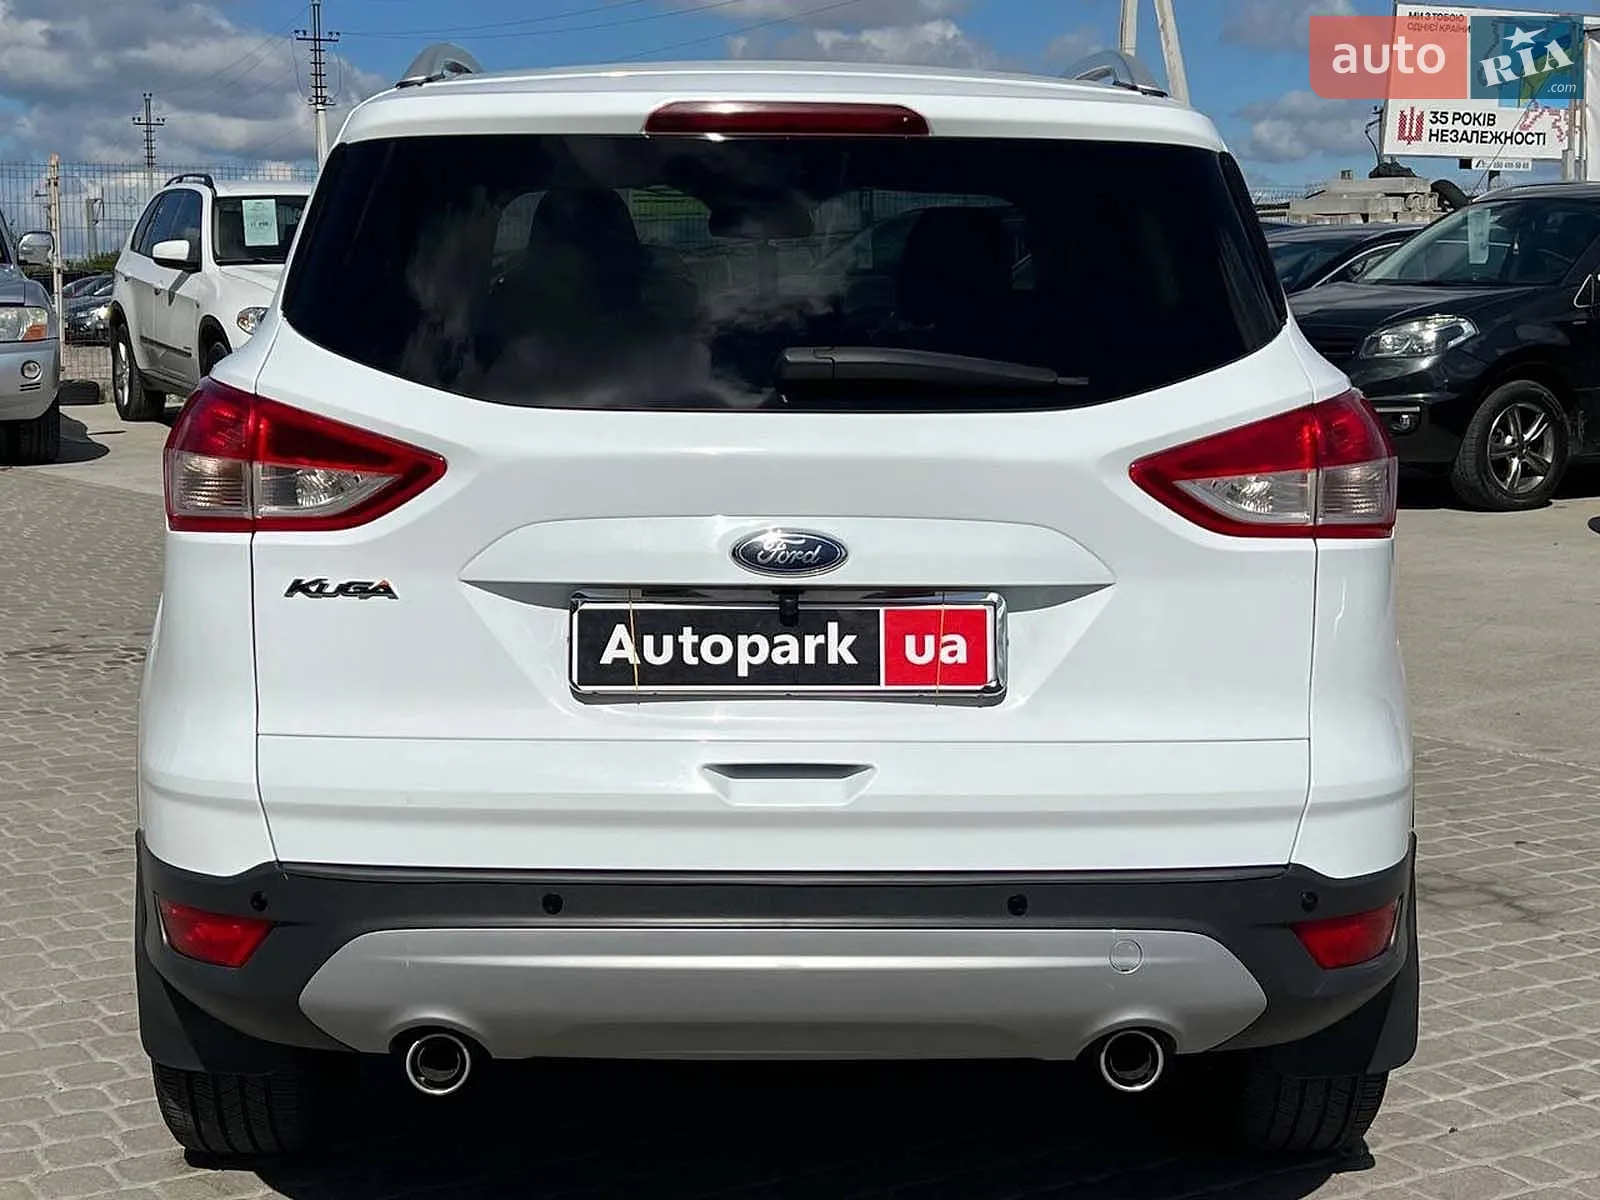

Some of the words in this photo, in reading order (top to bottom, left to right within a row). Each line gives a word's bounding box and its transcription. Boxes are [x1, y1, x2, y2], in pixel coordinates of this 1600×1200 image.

[1429, 111, 1449, 124] 35
[1452, 112, 1496, 126] РОКІВ
[1428, 129, 1546, 145] НЕЗАЛЕЖНОСТІ
[757, 532, 822, 564] Ford
[600, 622, 858, 677] Autopark
[904, 633, 967, 665] ua
